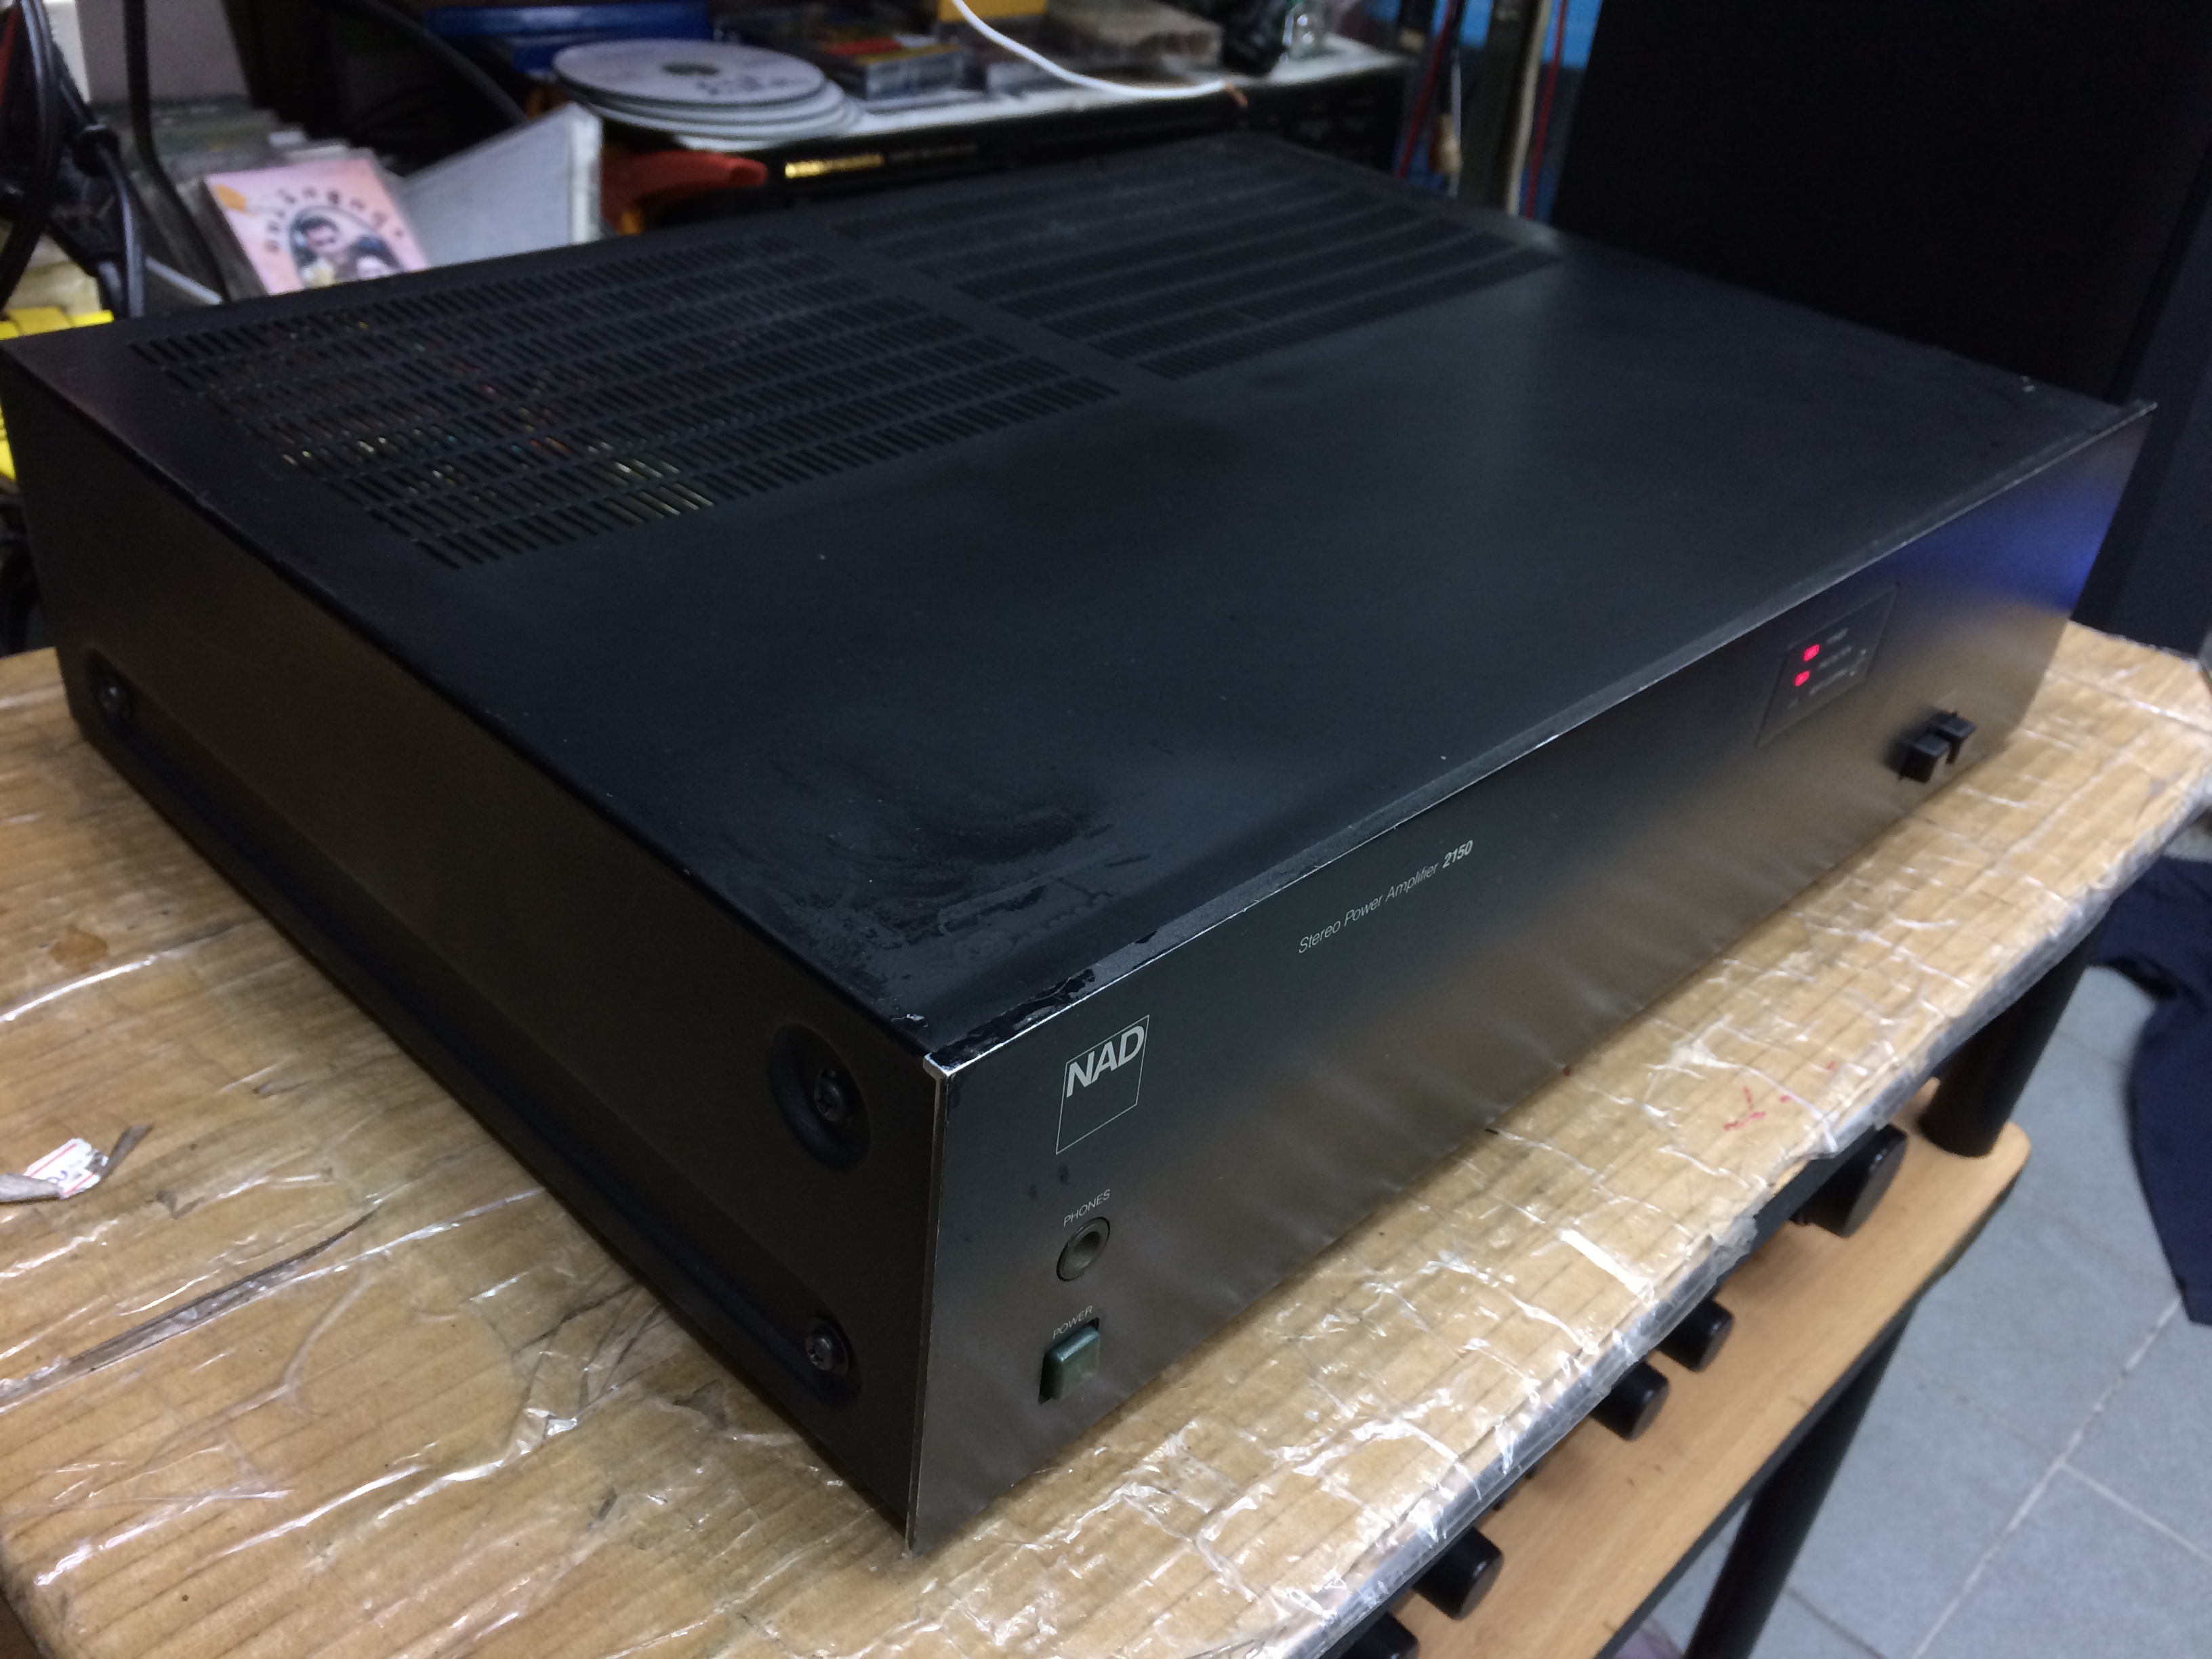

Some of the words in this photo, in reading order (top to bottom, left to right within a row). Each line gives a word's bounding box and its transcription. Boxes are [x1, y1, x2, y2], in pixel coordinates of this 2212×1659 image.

[1298, 920, 1340, 954] Stereo
[1344, 895, 1384, 927] Power
[1385, 862, 1439, 902] Amplifier
[1442, 840, 1473, 868] 2150
[1066, 1025, 1145, 1099] NAD
[1063, 1189, 1111, 1227] PHONES
[1052, 1305, 1093, 1340] POWER
